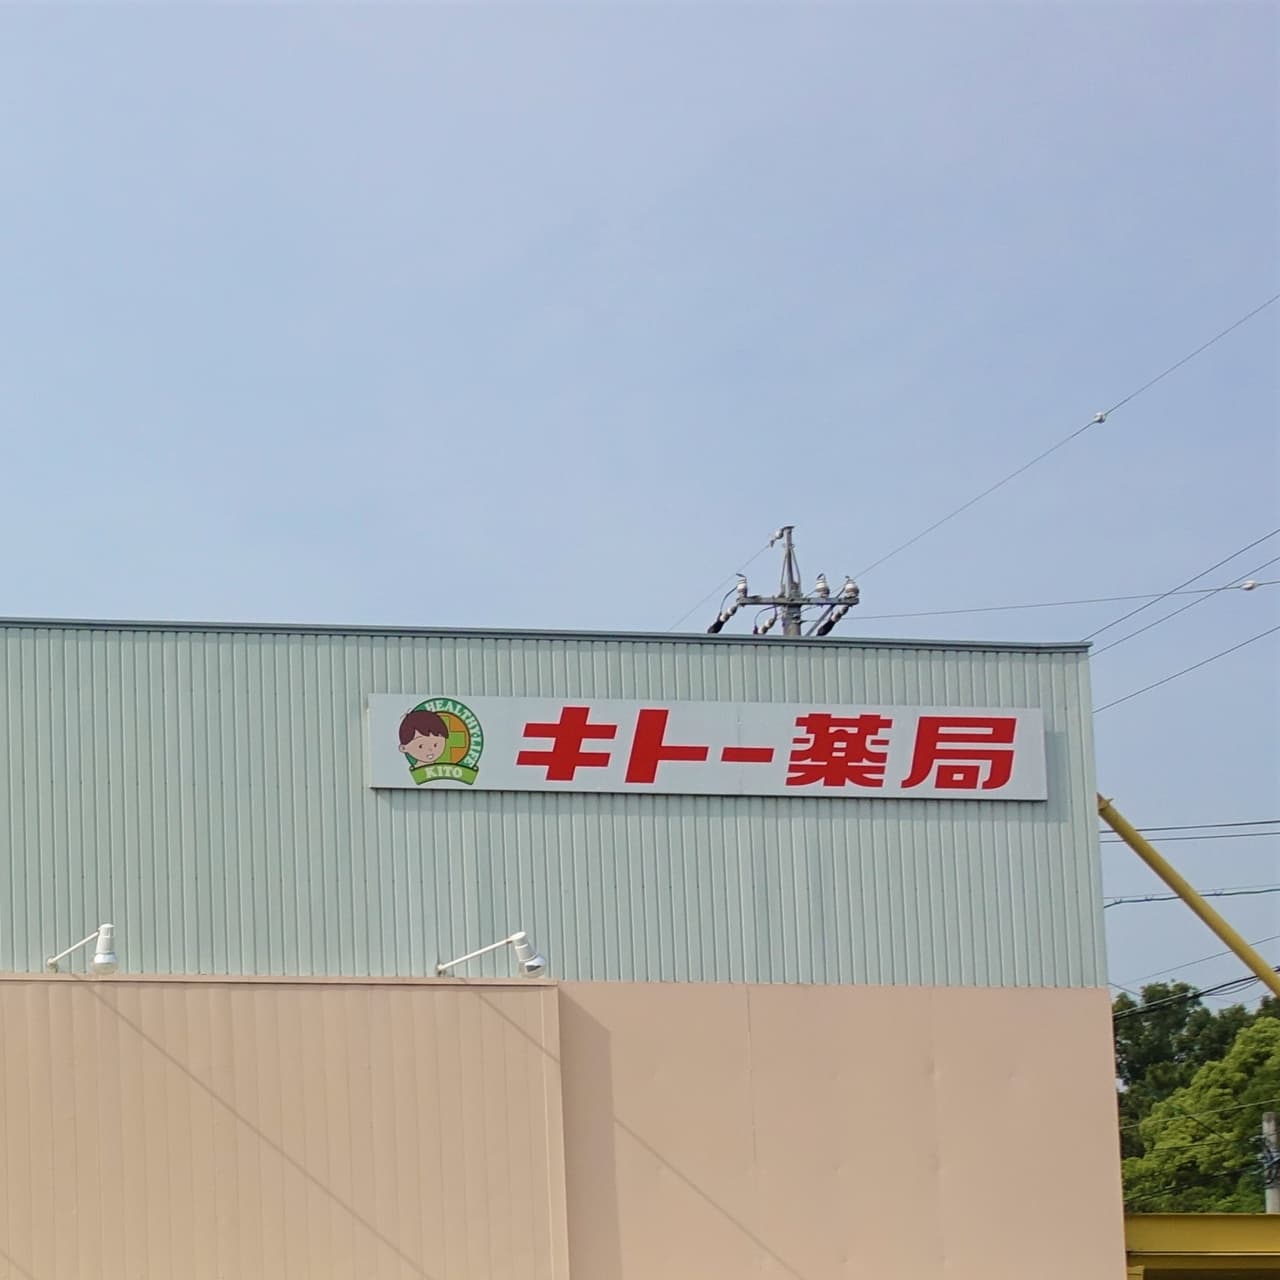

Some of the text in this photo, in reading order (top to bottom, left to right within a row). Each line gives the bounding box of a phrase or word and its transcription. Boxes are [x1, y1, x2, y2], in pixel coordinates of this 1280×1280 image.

[425, 766, 463, 778] KITO
[516, 706, 1017, 790] キトー薬局
